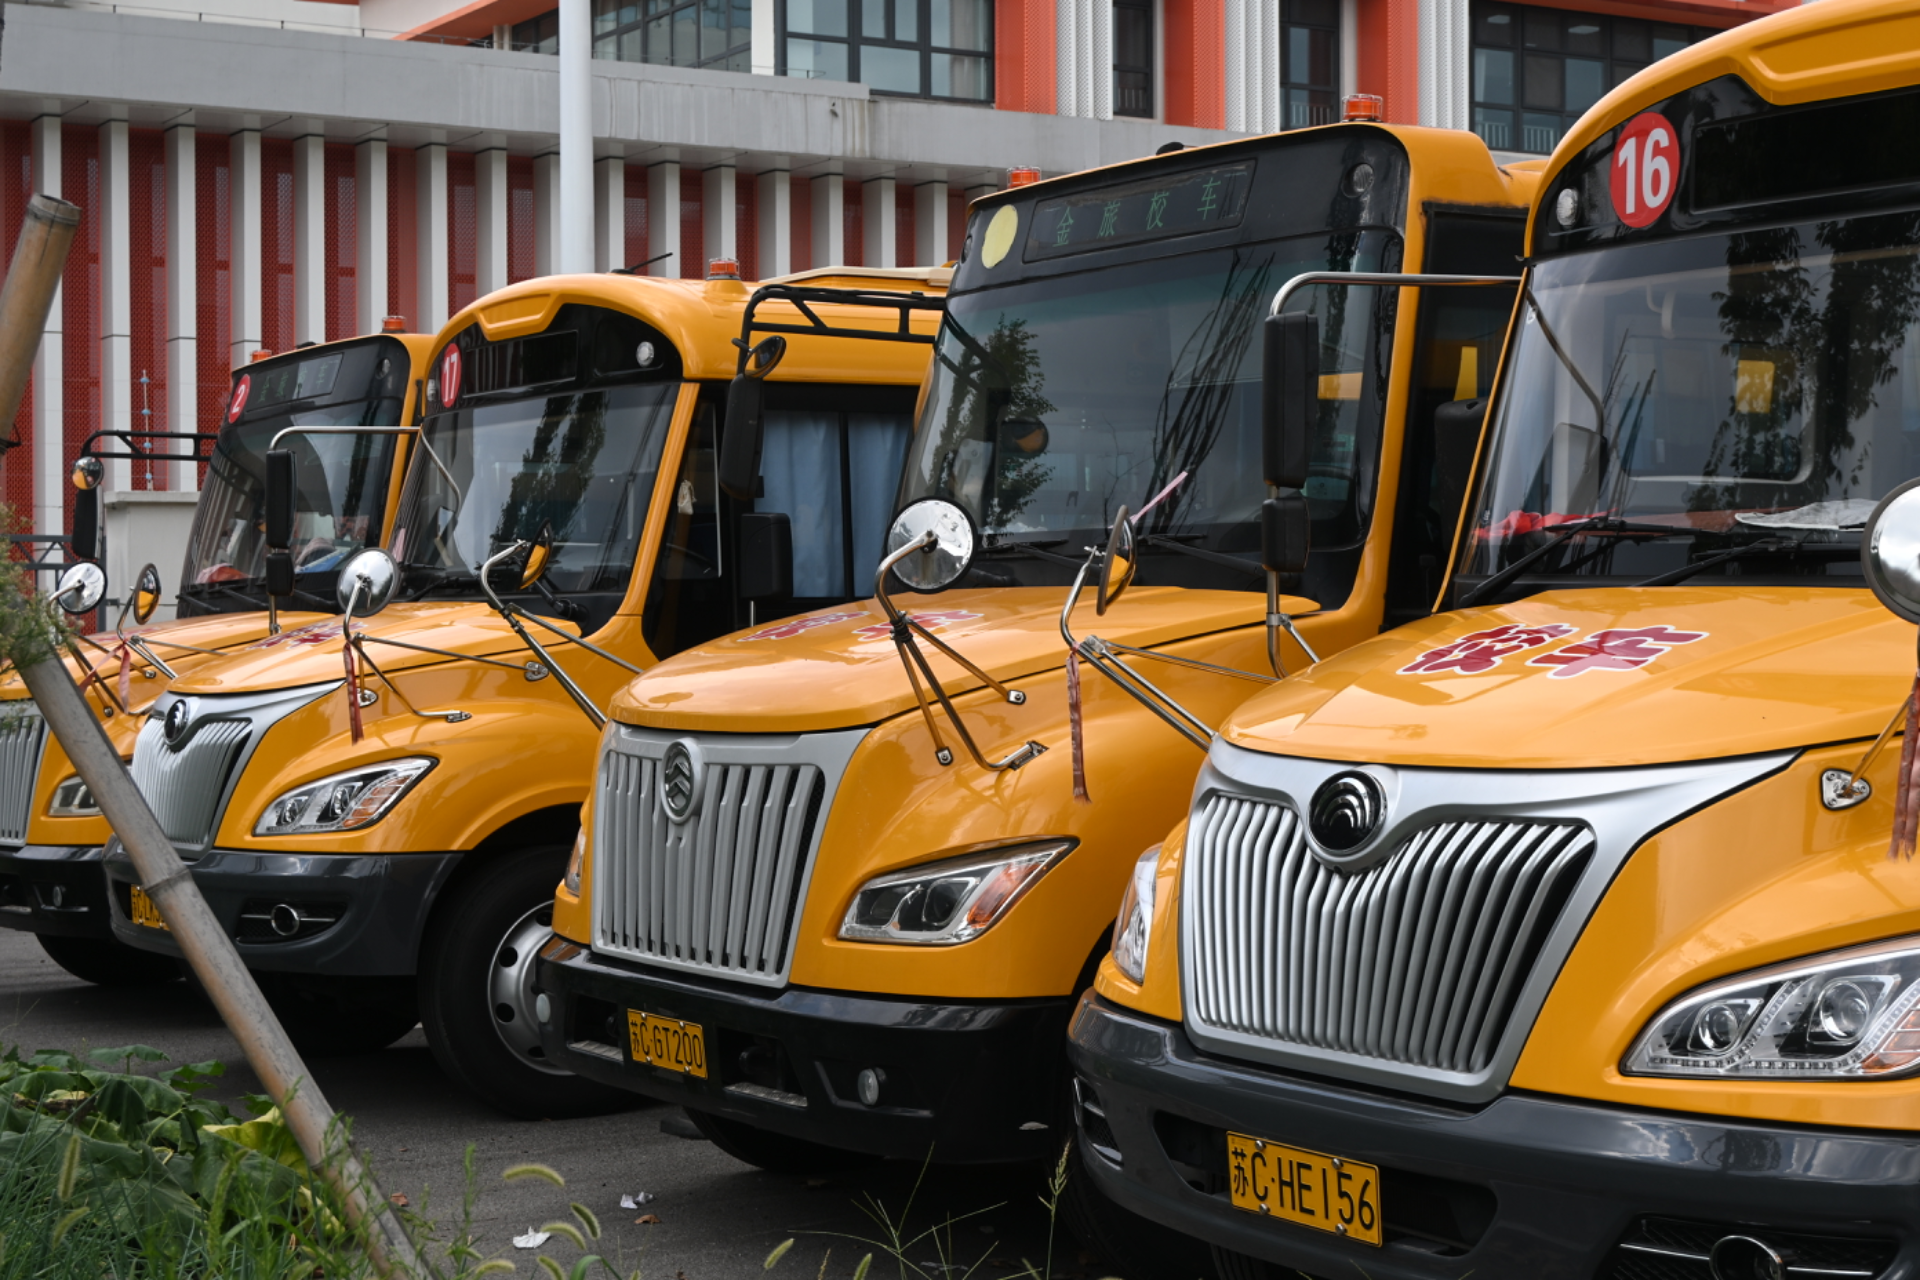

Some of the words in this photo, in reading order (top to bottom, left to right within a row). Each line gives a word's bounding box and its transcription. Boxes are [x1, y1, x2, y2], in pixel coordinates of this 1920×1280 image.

[1618, 127, 1671, 215] 16
[1051, 176, 1221, 248] 金旅校车
[232, 384, 246, 414] 2
[443, 352, 458, 402] 17
[1396, 623, 1709, 679] 校车
